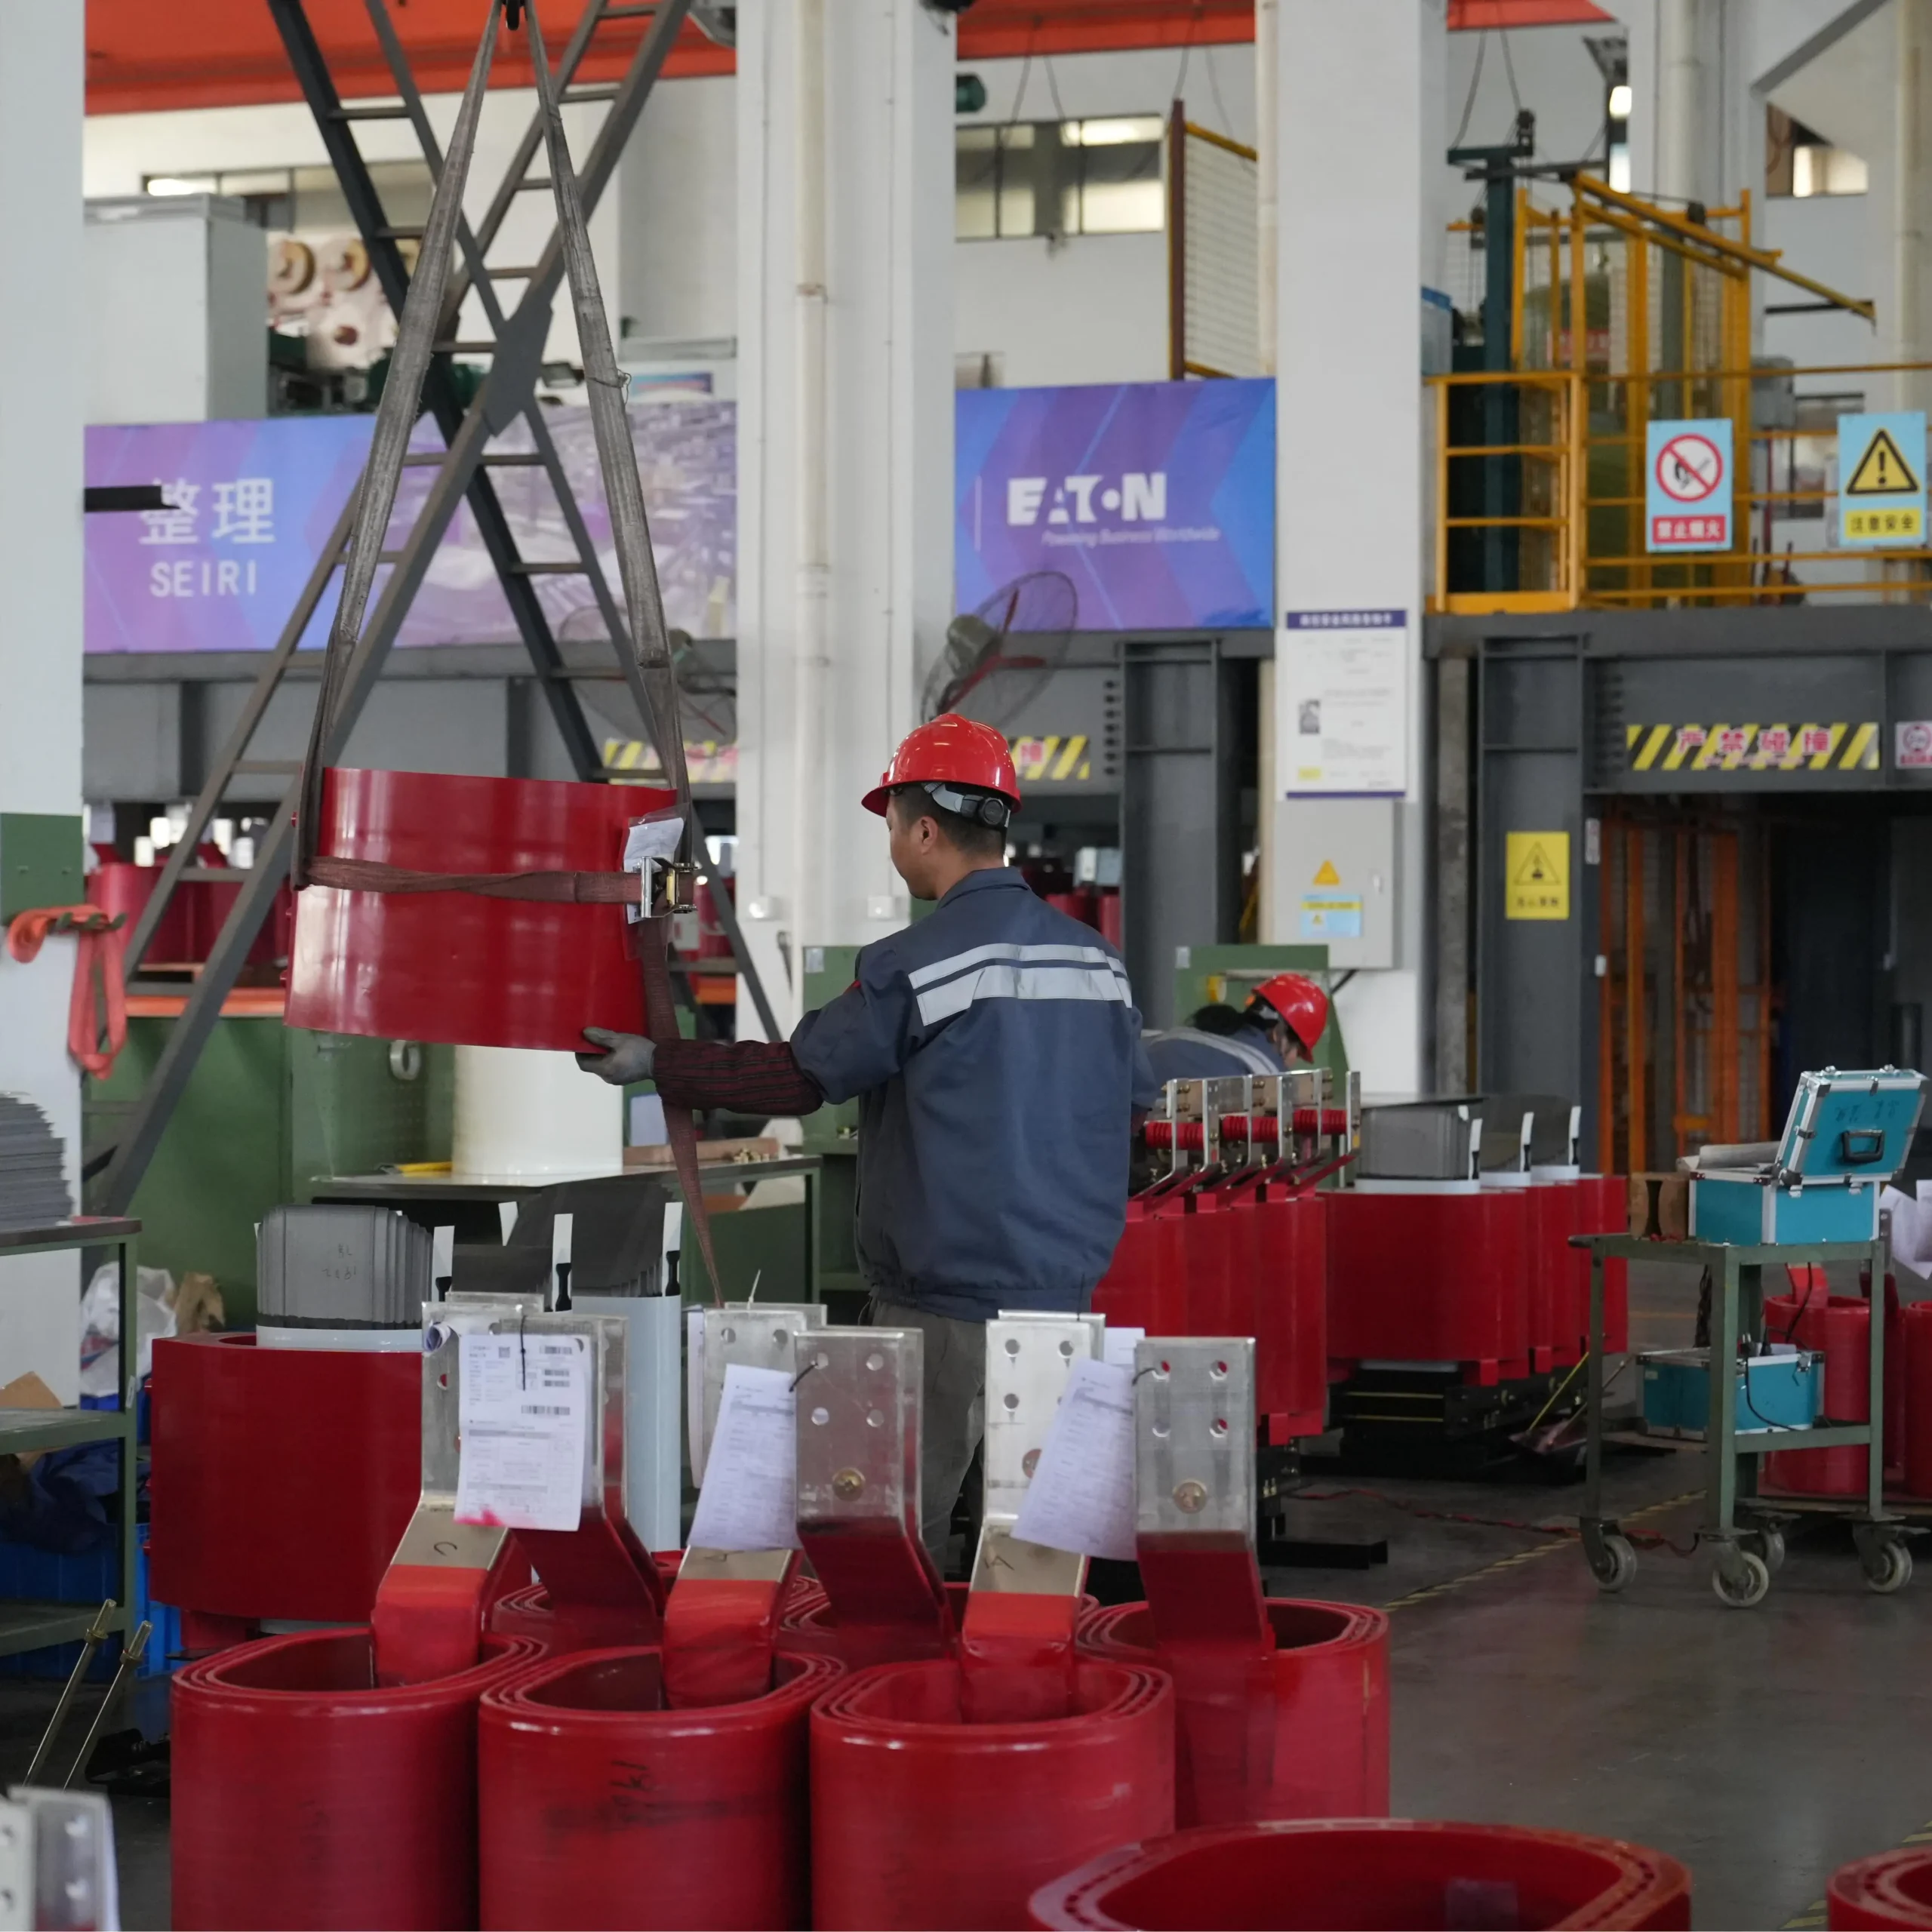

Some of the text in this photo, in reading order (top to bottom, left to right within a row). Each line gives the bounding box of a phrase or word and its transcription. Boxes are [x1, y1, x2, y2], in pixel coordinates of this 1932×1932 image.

[139, 478, 275, 545] 整理
[1008, 472, 1167, 526] EATON
[150, 559, 256, 598] SEIRI
[1678, 728, 1832, 755] 严禁碰撞
